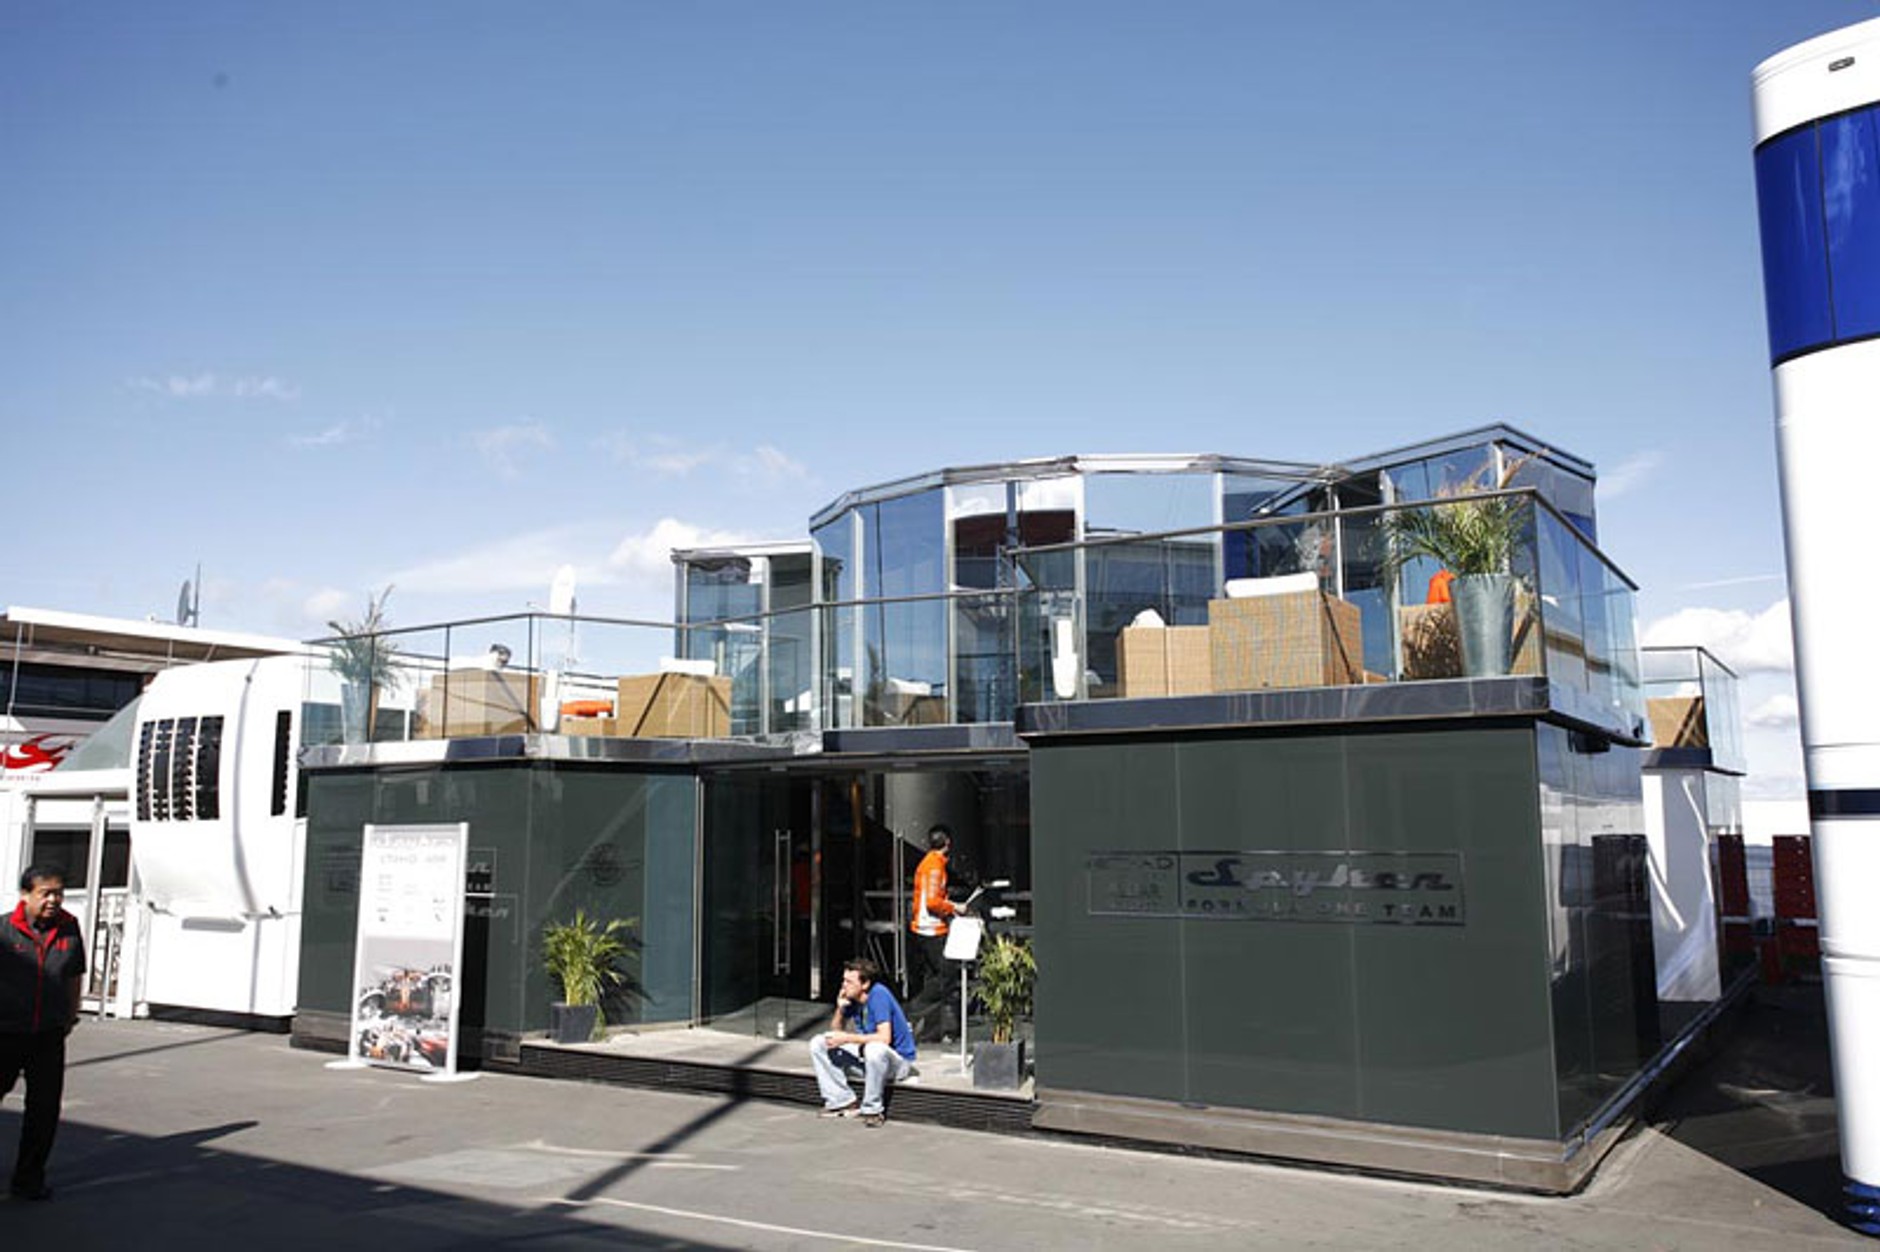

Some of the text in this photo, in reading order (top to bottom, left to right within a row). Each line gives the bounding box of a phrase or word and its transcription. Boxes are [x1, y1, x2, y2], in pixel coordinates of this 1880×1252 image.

[1186, 858, 1454, 897] Spyker
[1186, 899, 1297, 914] FORLA
[1382, 903, 1456, 918] TEAM
